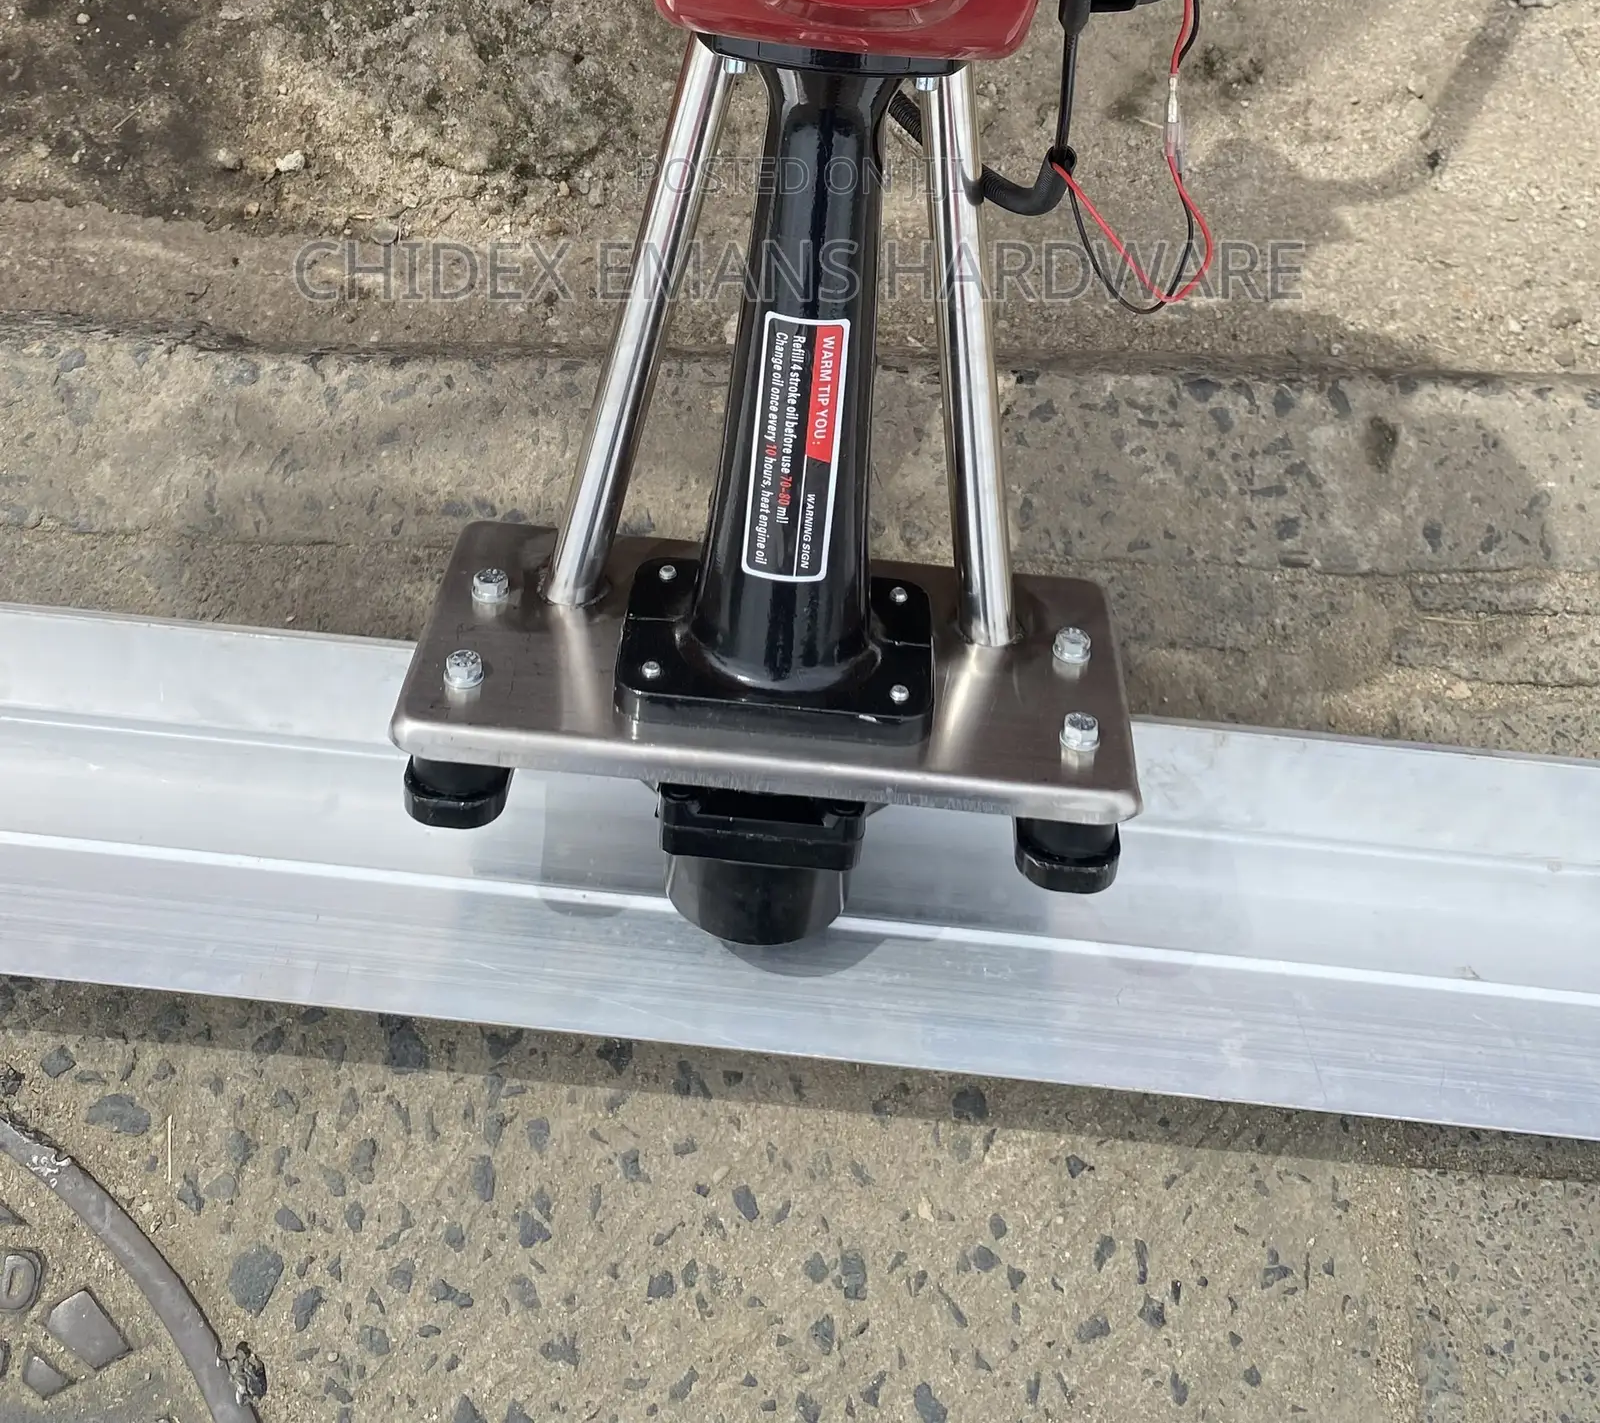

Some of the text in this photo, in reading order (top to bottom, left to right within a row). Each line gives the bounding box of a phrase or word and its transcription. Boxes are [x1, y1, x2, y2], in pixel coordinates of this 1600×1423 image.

[791, 335, 806, 363] Refill
[818, 335, 836, 382] WARM
[788, 372, 801, 405] stroke
[817, 384, 831, 406] TIP
[786, 407, 799, 421] oil
[755, 332, 788, 565] Change oil once every 10 hours, heat engine oil
[782, 421, 798, 455] before
[780, 455, 792, 474] use
[777, 475, 792, 506] 70-80
[800, 493, 816, 569] WARNING SIGN
